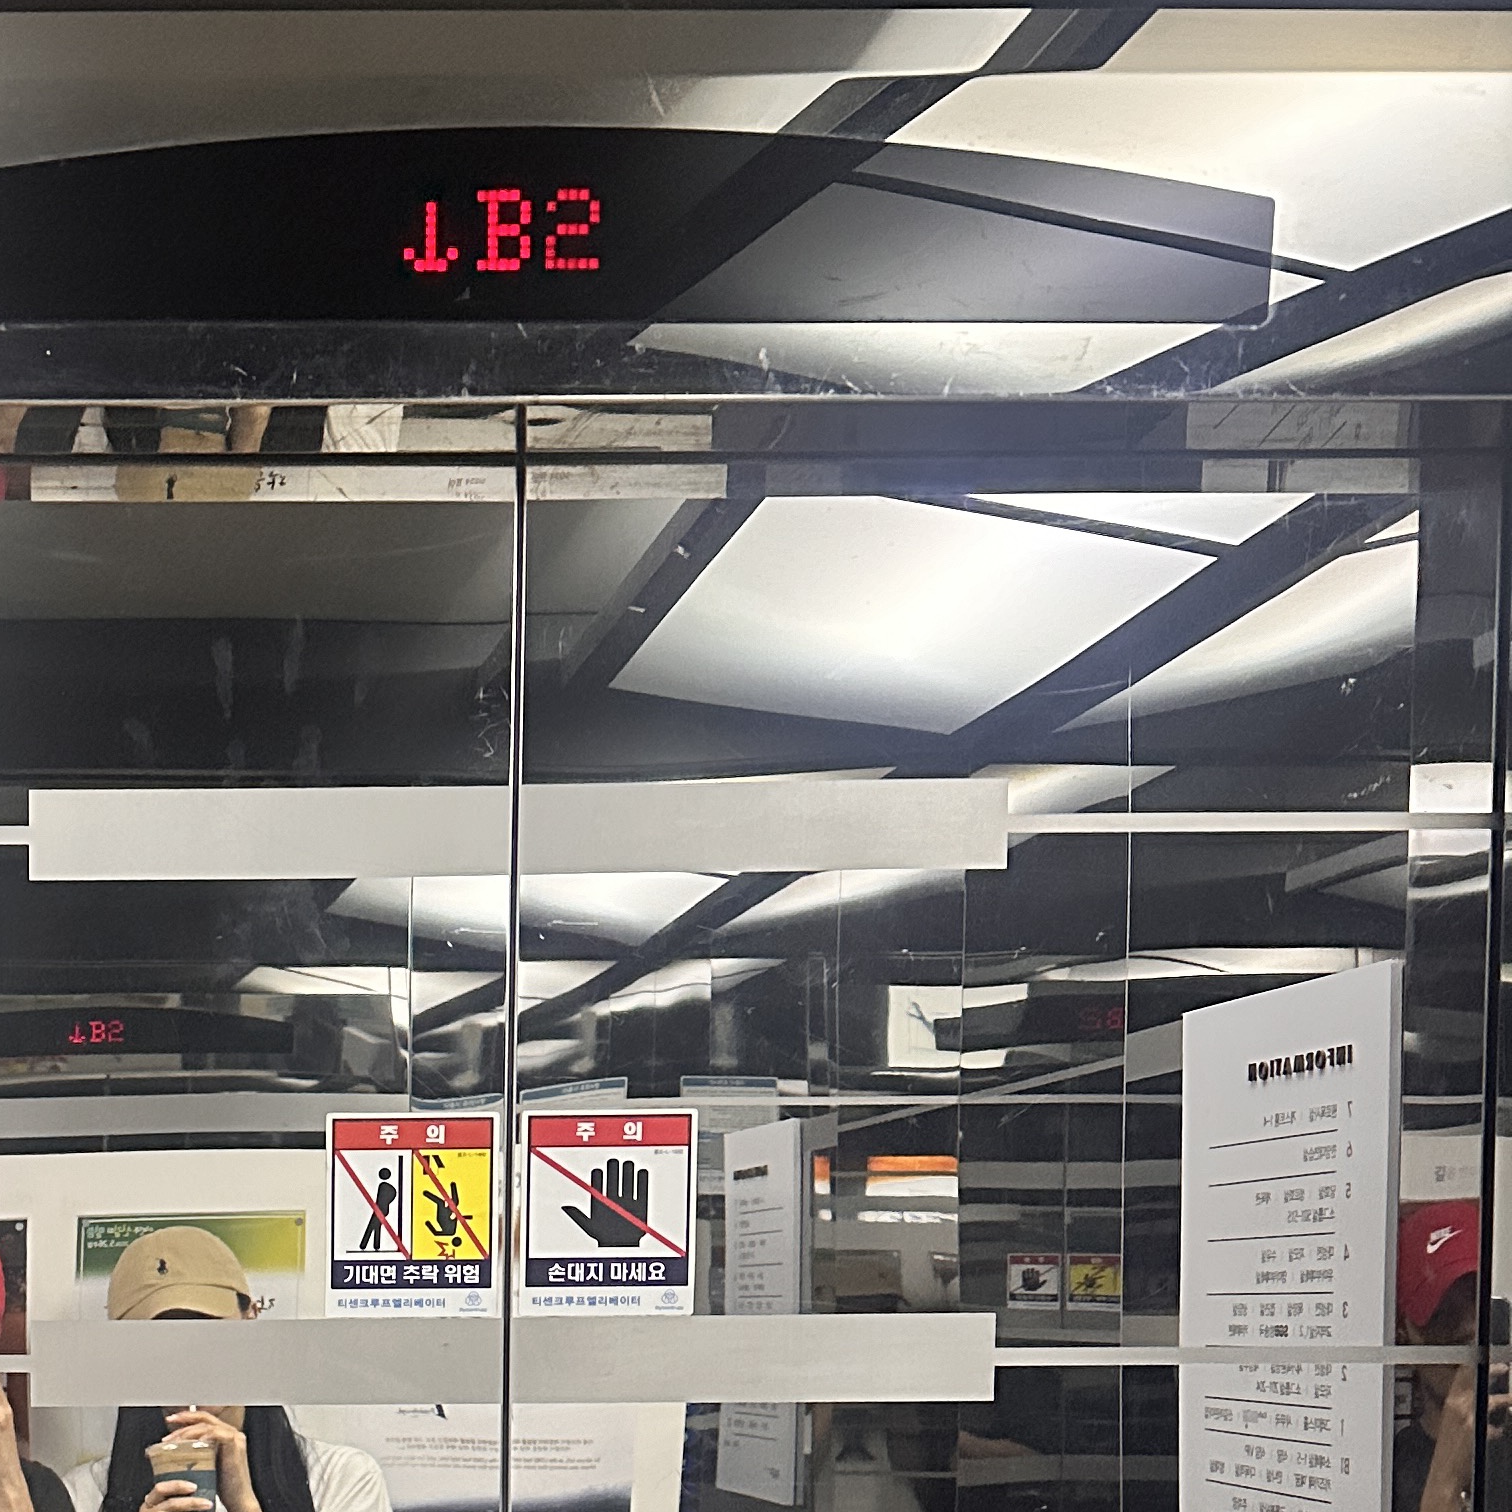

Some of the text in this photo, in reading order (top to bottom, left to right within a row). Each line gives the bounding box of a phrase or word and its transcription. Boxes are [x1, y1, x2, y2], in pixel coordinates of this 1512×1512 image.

[476, 186, 602, 273] B2
[343, 1264, 480, 1285] 기대면 추락 위험
[547, 1261, 666, 1283] 손대지 마세요
[337, 1298, 446, 1309] 티센크루프엘리베이터
[531, 1295, 641, 1307] 티센크루프엘리베이터
